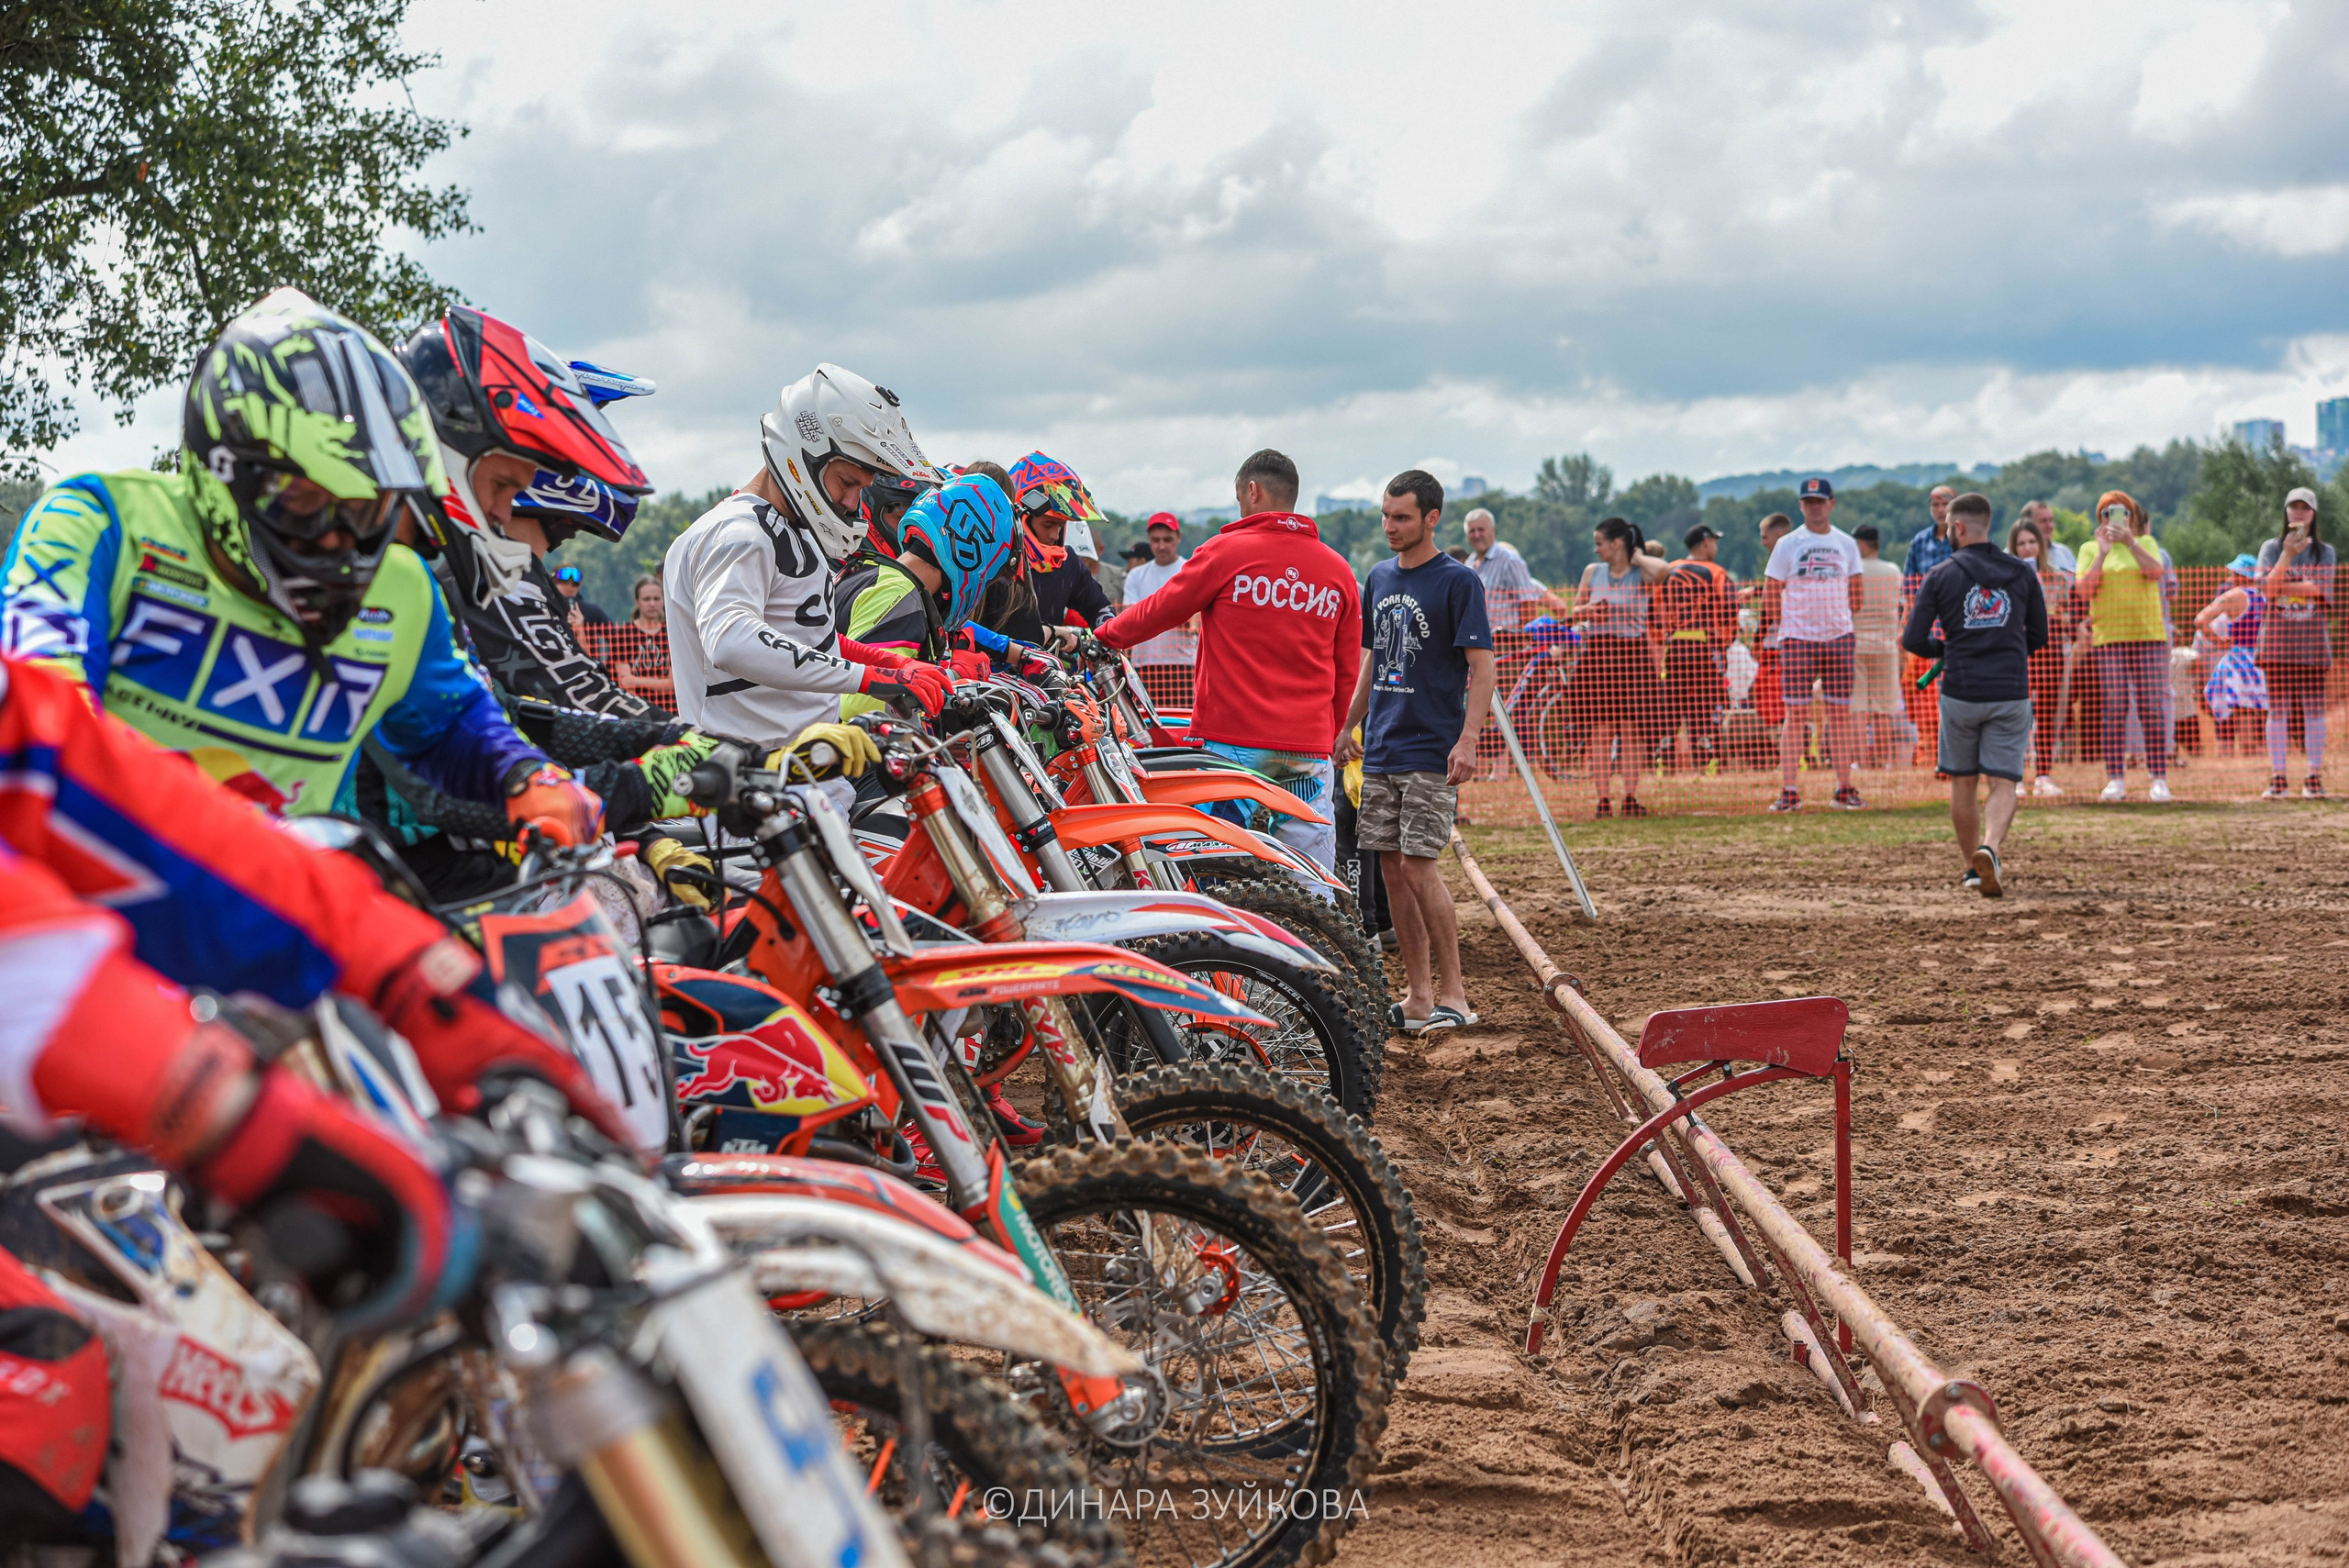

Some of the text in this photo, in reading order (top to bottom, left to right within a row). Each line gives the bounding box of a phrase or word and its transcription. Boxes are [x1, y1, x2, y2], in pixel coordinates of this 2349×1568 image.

[796, 416, 812, 441] CAMP
[800, 411, 819, 442] RIDERS
[808, 413, 824, 435] DIRT
[1232, 574, 1340, 619] РОССИЯ
[1377, 594, 1431, 639] YORK FAST FOOD
[112, 601, 386, 735] FXR
[991, 979, 1061, 995] POWERPARTS
[1093, 964, 1188, 990] ACERBIS
[1277, 981, 1301, 1002] EXCEL
